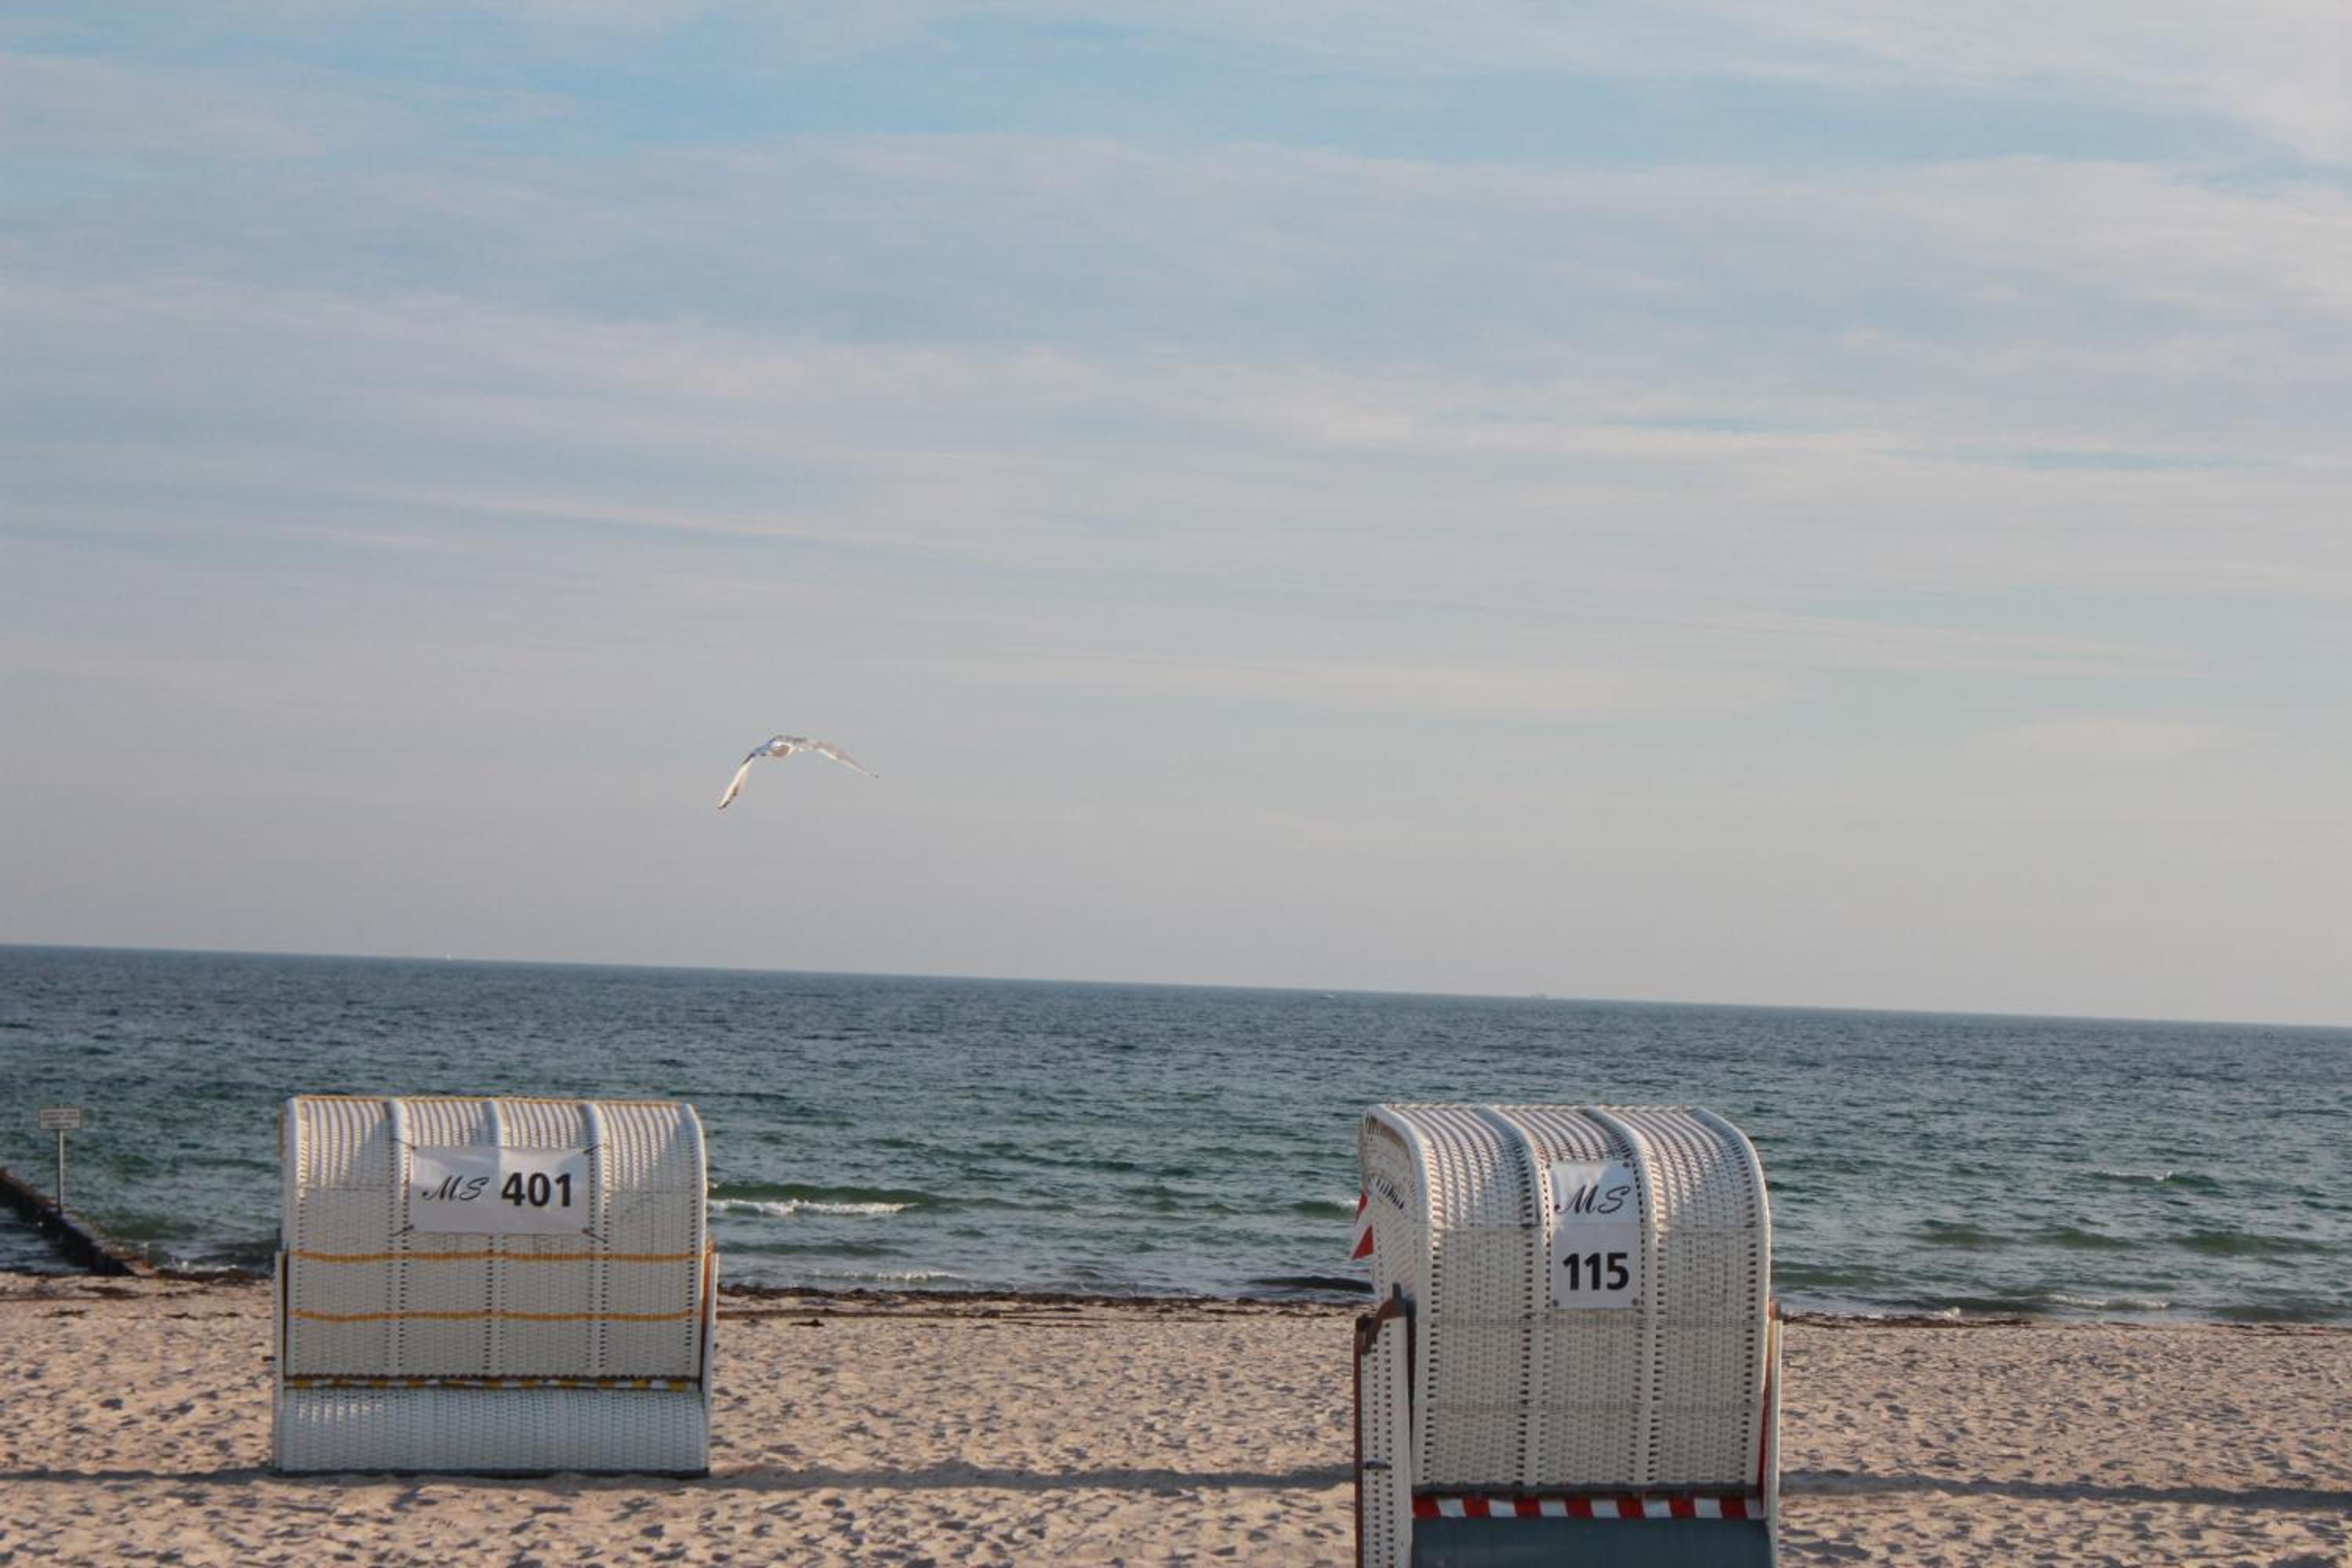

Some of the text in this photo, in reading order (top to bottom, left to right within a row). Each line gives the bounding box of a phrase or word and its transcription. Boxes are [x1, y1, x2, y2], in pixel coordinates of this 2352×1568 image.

[422, 1172, 572, 1207] MS 401
[1554, 1185, 1631, 1214] MS
[1563, 1252, 1629, 1290] 115
